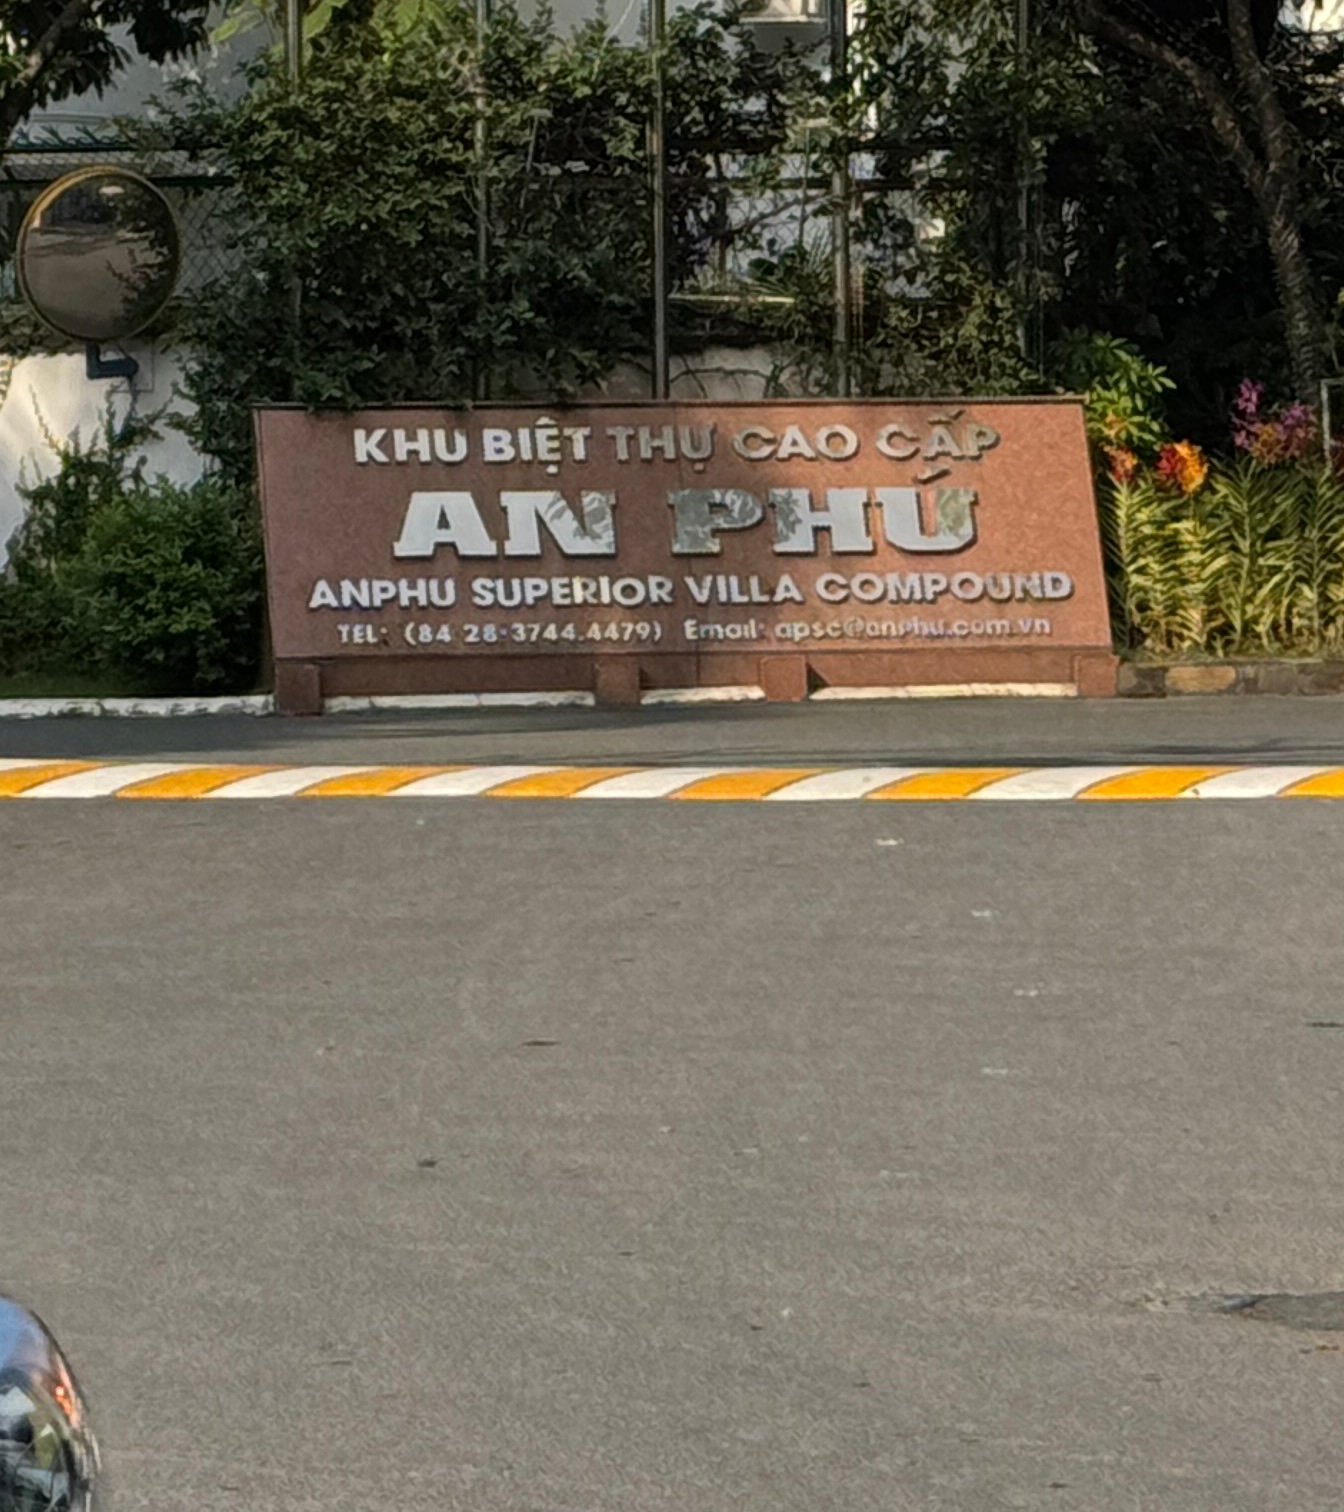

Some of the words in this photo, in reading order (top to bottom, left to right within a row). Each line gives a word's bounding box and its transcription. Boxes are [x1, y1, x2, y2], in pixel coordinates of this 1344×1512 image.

[353, 427, 468, 463] KHU
[482, 416, 591, 474] BIỆT
[607, 423, 715, 471] THỤ
[733, 424, 859, 461] CAO
[876, 410, 1001, 461] CẤP
[393, 491, 617, 557] AN
[667, 466, 979, 556] PHÚ
[308, 578, 456, 608] ANPHU
[471, 575, 674, 607] SUPERIOR
[684, 573, 805, 603] VILLA
[815, 571, 1074, 602] COMPOUND
